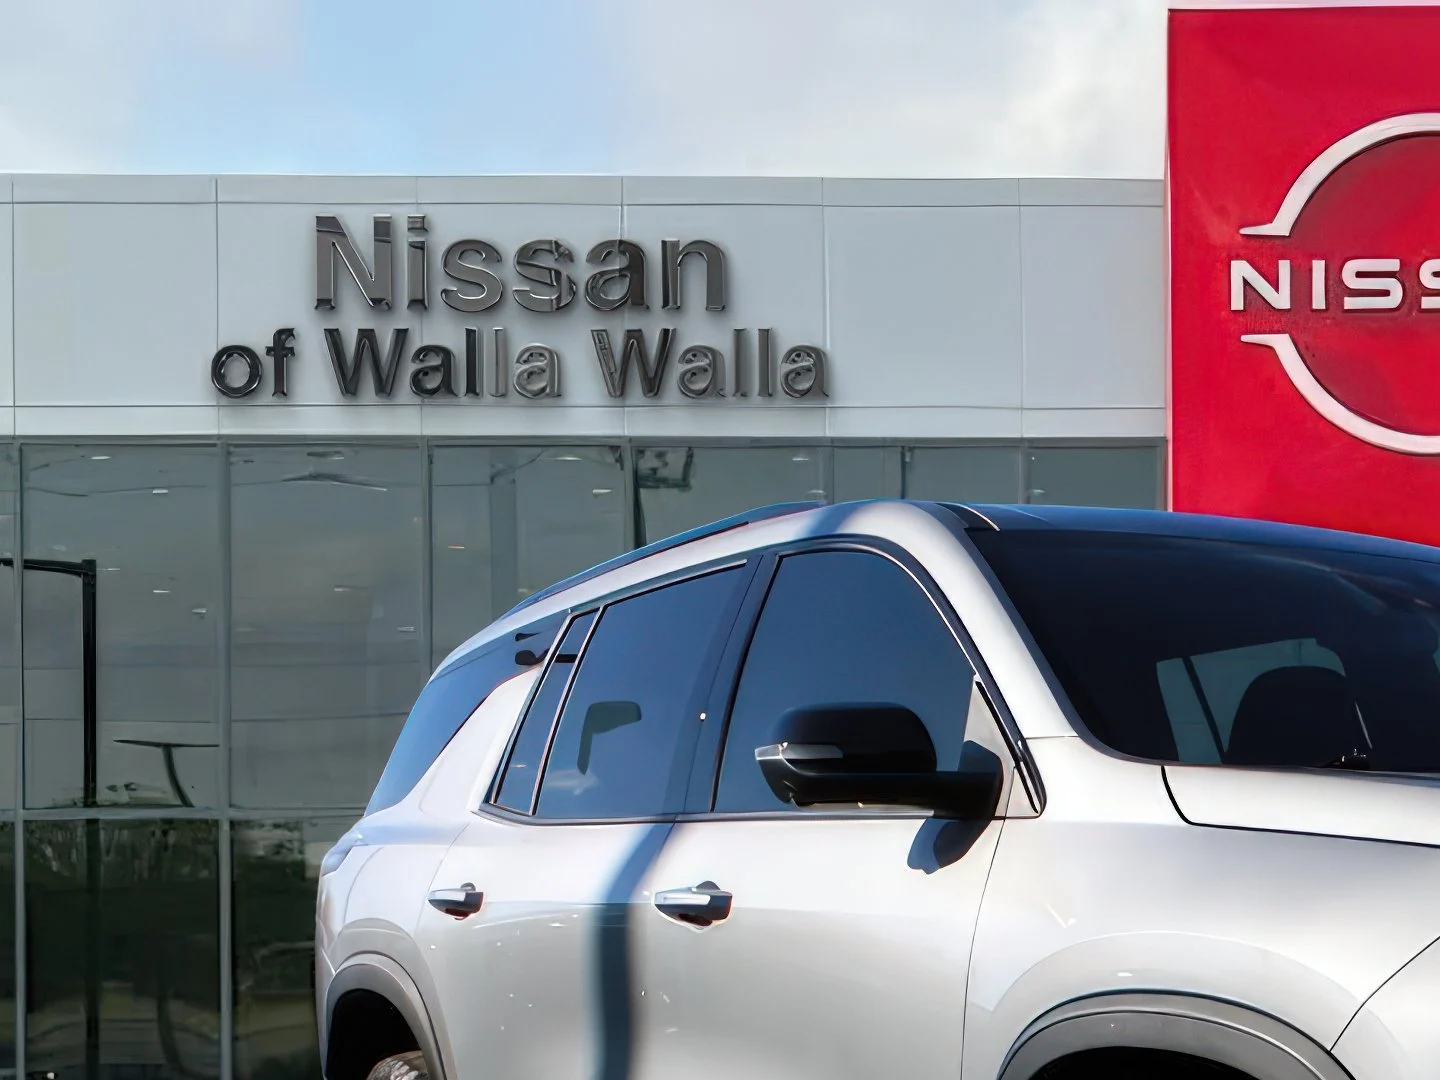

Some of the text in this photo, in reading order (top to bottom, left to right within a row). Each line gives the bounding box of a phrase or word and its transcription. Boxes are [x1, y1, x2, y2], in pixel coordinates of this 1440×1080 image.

[314, 213, 727, 312] Nissan
[210, 327, 830, 399] of Walla Walla
